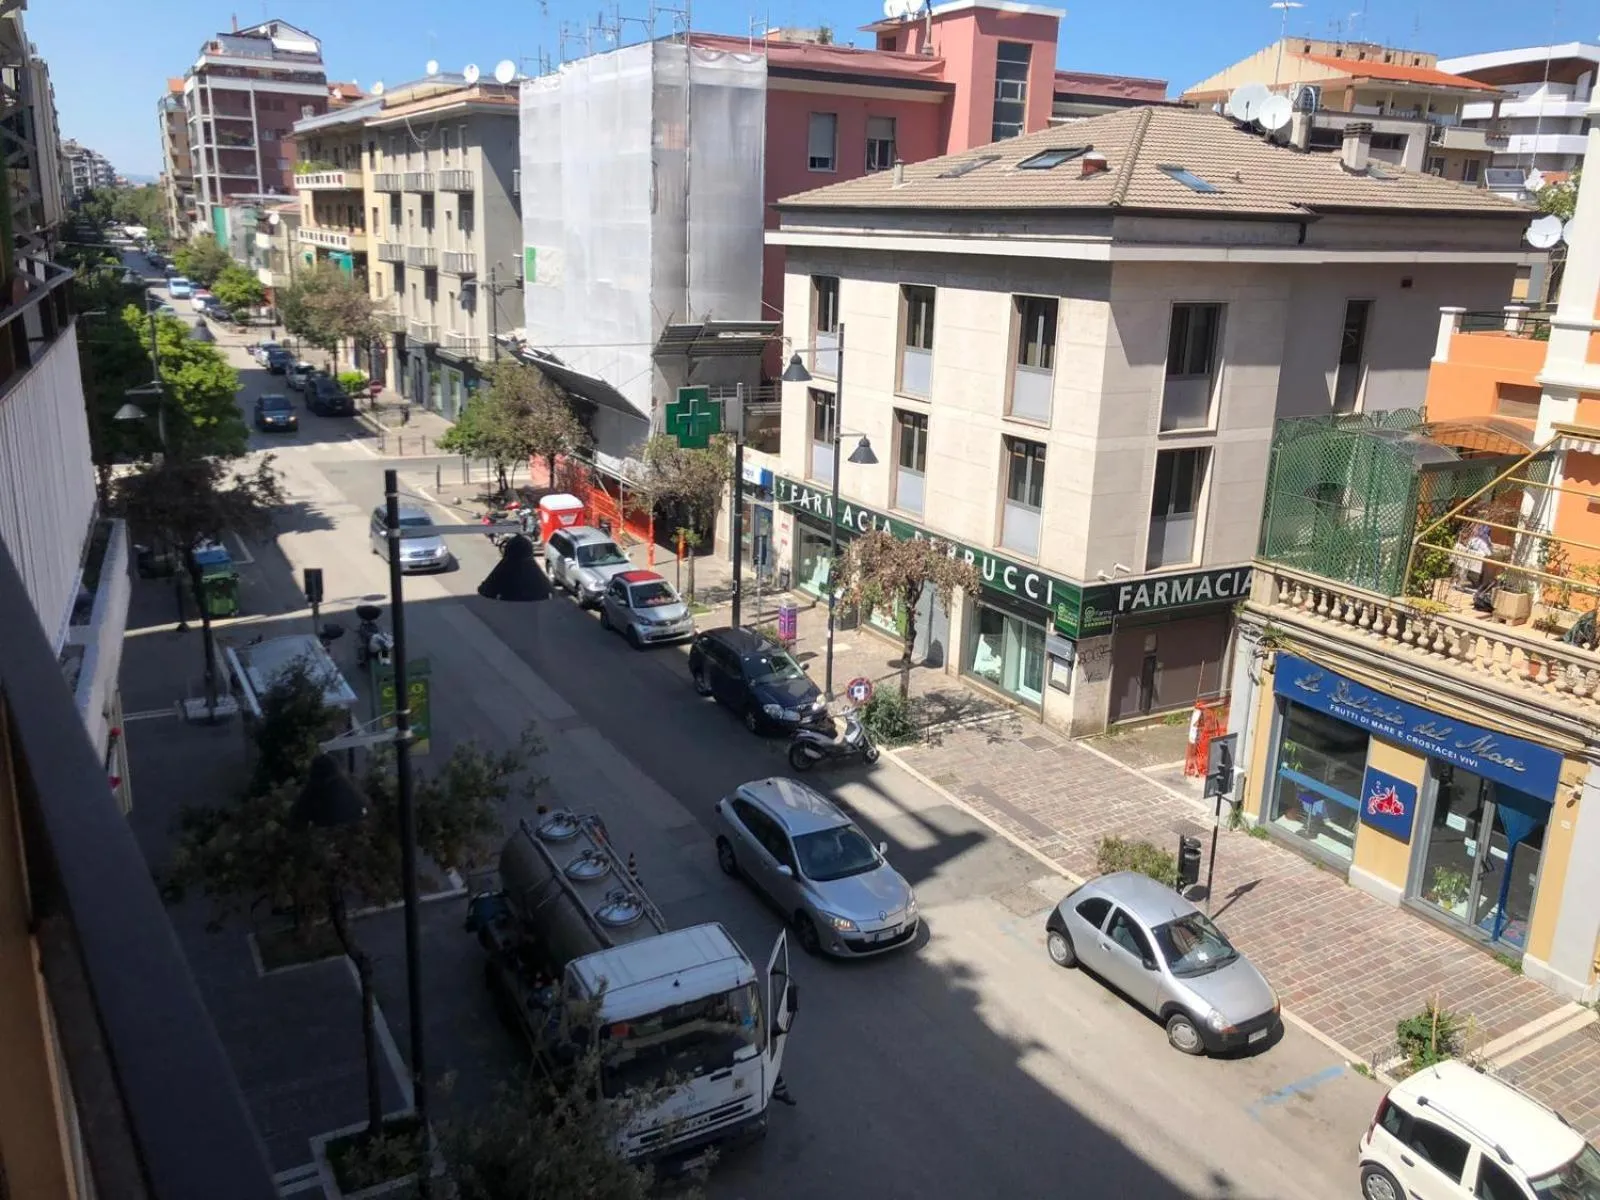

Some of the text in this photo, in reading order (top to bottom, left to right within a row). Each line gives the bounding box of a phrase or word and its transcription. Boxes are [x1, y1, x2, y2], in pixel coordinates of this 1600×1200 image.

[1118, 571, 1251, 611] FARMACIA
[1329, 704, 1358, 720] FRUTTI
[1360, 717, 1369, 725] DI
[1371, 720, 1395, 734] MARE
[1406, 734, 1457, 759] CROSTACEI
[1459, 755, 1478, 767] VIVI
